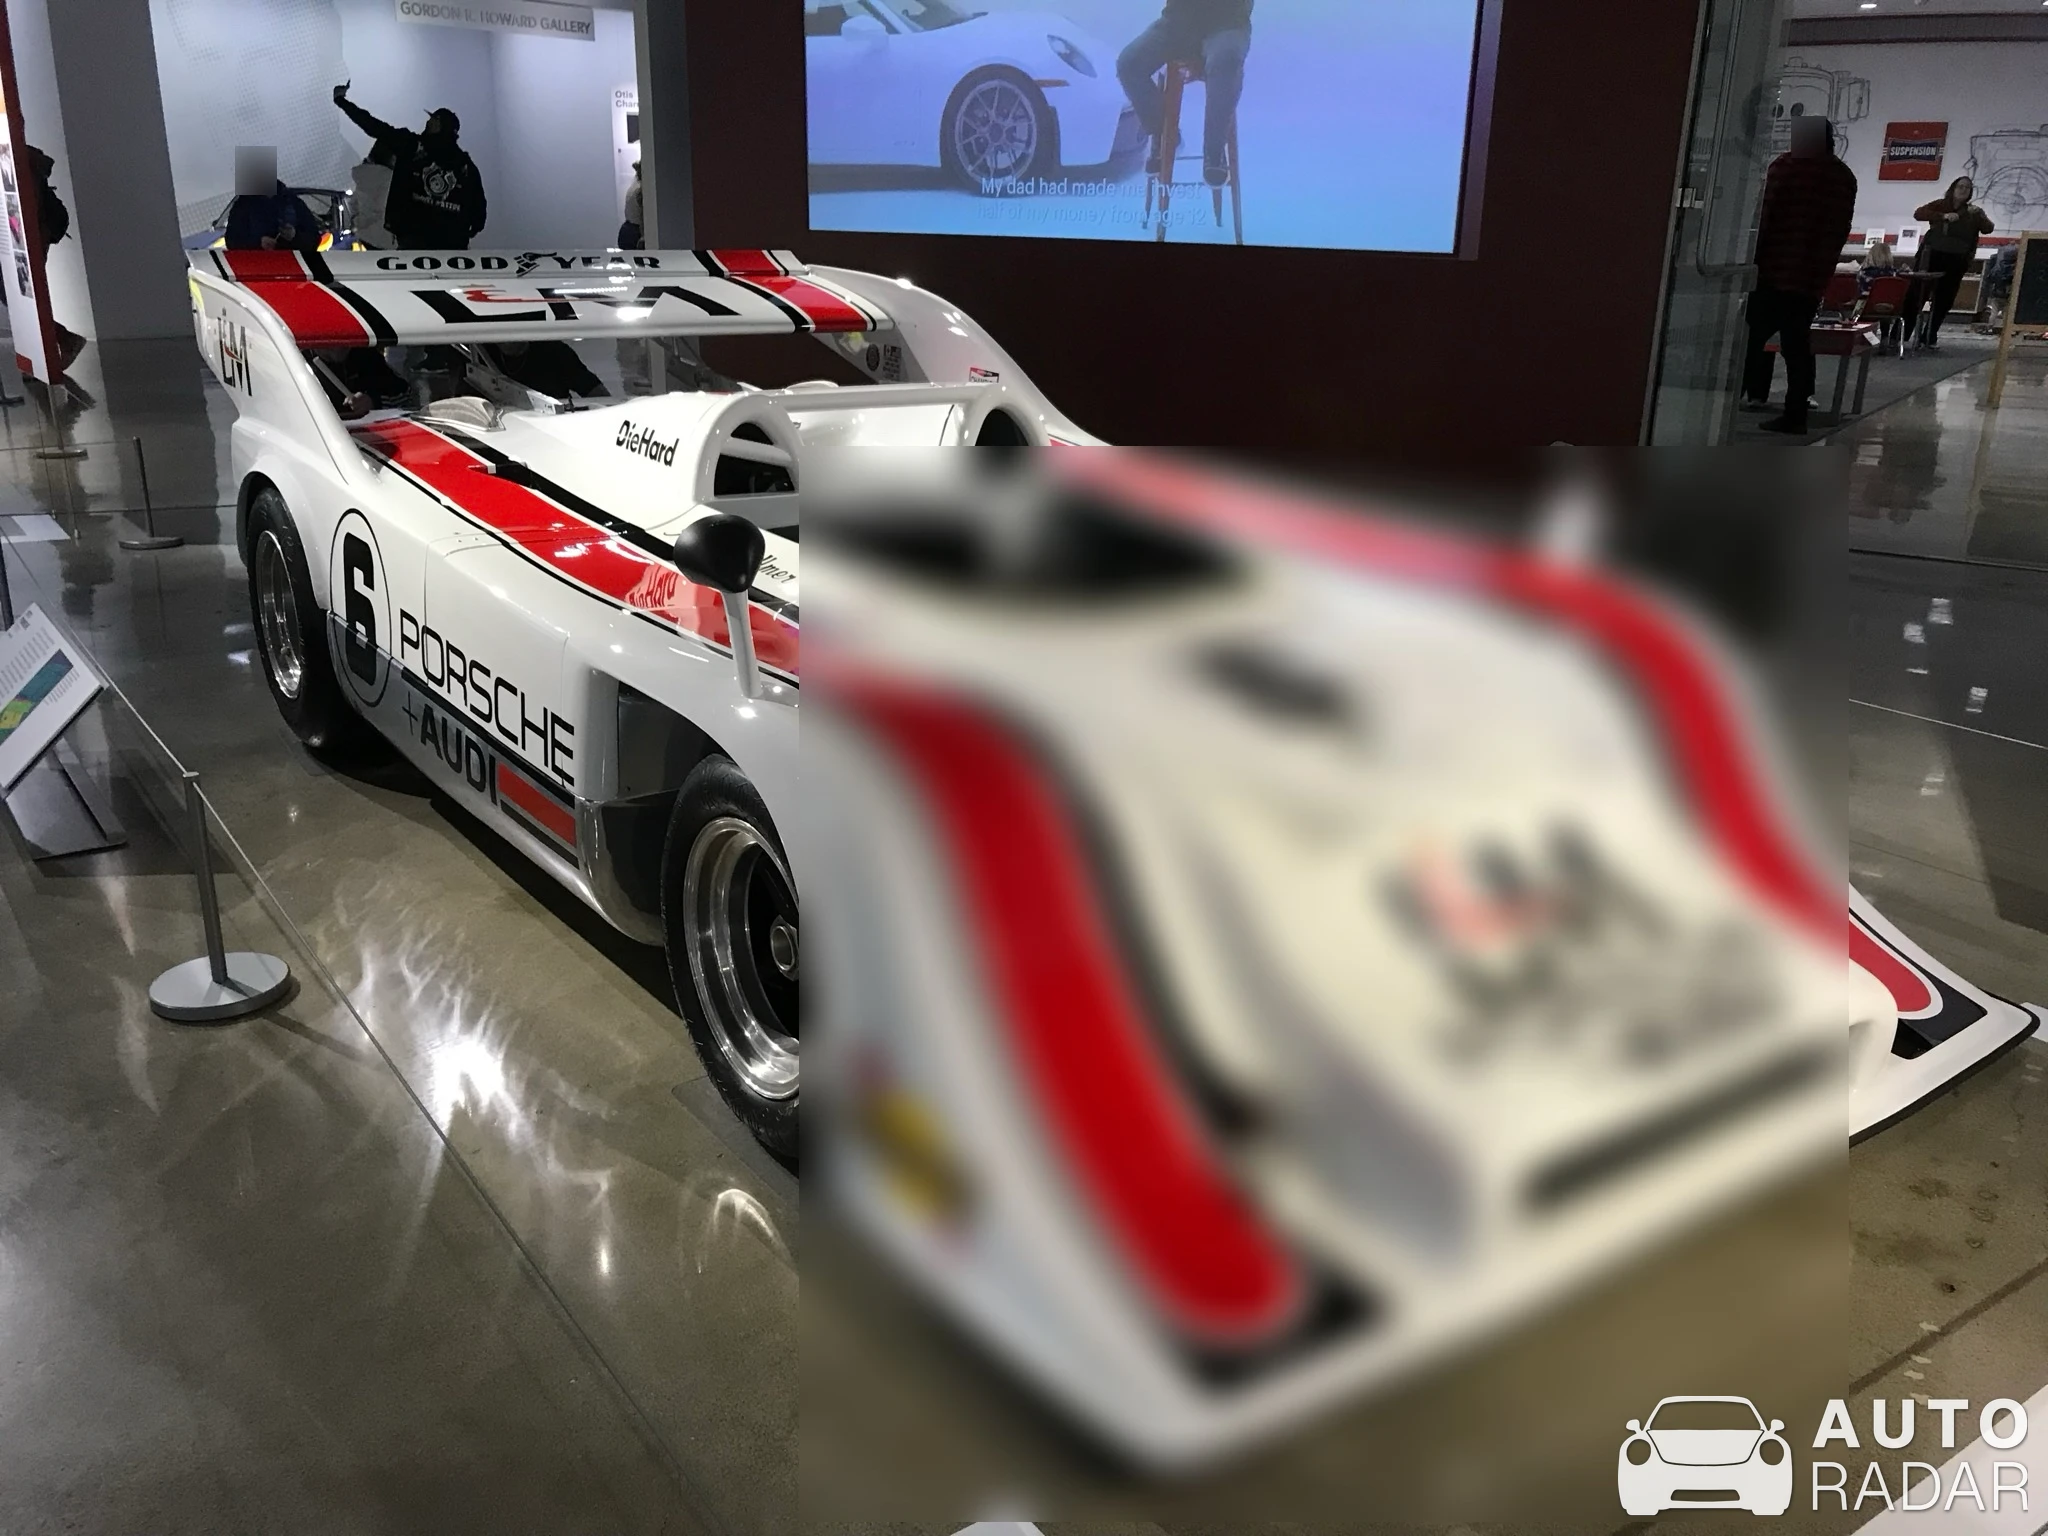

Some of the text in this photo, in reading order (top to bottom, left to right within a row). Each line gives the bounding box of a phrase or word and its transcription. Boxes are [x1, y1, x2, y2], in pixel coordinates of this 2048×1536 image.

[400, 1, 460, 21] GORDON
[481, 11, 537, 28] HOWARD
[540, 17, 591, 34] GALLERY
[615, 90, 634, 99] Otis
[1889, 146, 1937, 156] SUSPENSION
[981, 178, 1002, 198] My
[1006, 177, 1035, 195] dad
[1039, 177, 1068, 196] had
[1072, 177, 1116, 197] made
[1151, 179, 1201, 199] invest
[1053, 207, 1107, 224] money
[615, 419, 680, 467] DieHard
[343, 532, 377, 686] 6
[400, 608, 575, 788] PORSCHE
